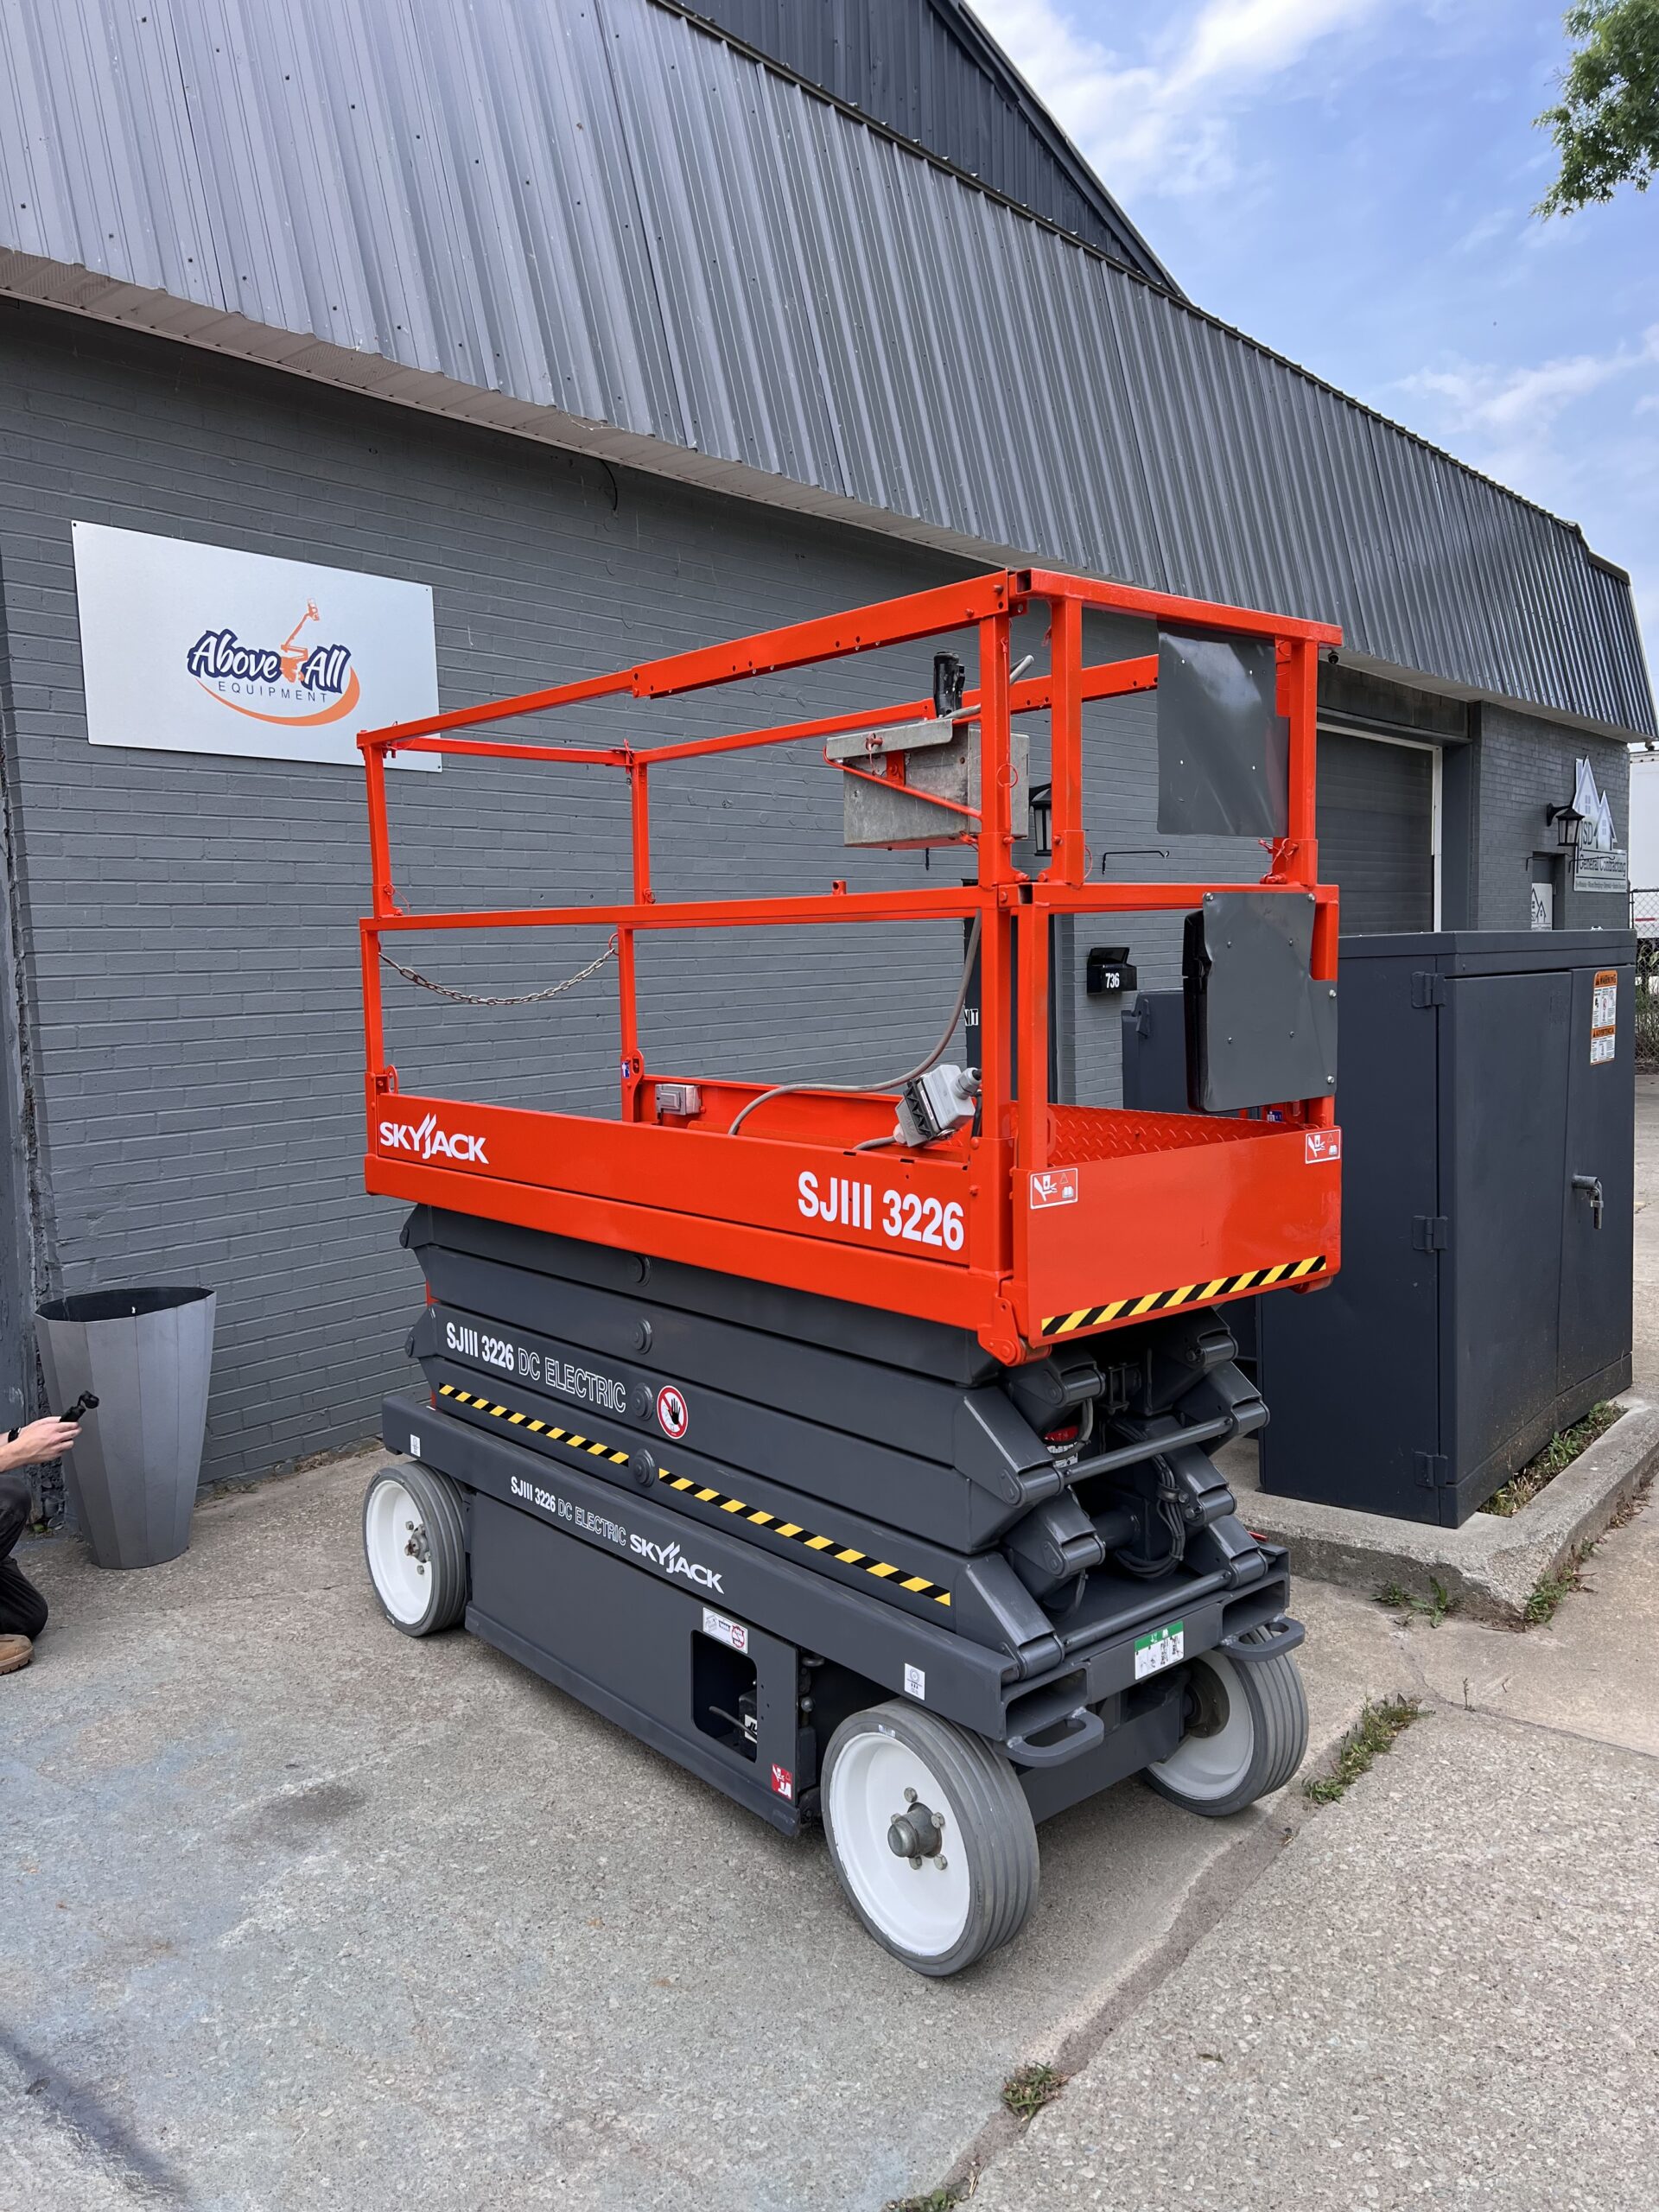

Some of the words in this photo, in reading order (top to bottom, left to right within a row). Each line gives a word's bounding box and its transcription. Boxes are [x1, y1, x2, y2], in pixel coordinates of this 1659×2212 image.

[188, 629, 281, 683] Above
[299, 645, 351, 692] All
[219, 681, 327, 703] EQUIPMENT
[1105, 973, 1120, 988] 736
[380, 1112, 489, 1164] SKYJACK
[798, 1171, 872, 1230] SJIII
[882, 1189, 964, 1251] 3226
[446, 1322, 479, 1357] SJIII
[481, 1335, 514, 1371] 3226
[518, 1347, 540, 1381] DC
[545, 1357, 626, 1413] ELECTRIC
[511, 1476, 533, 1502] SJIII
[535, 1486, 556, 1512] 3226
[557, 1497, 573, 1521] DC
[575, 1506, 626, 1547] ELECTRIC
[630, 1534, 724, 1594] SKYJACK
